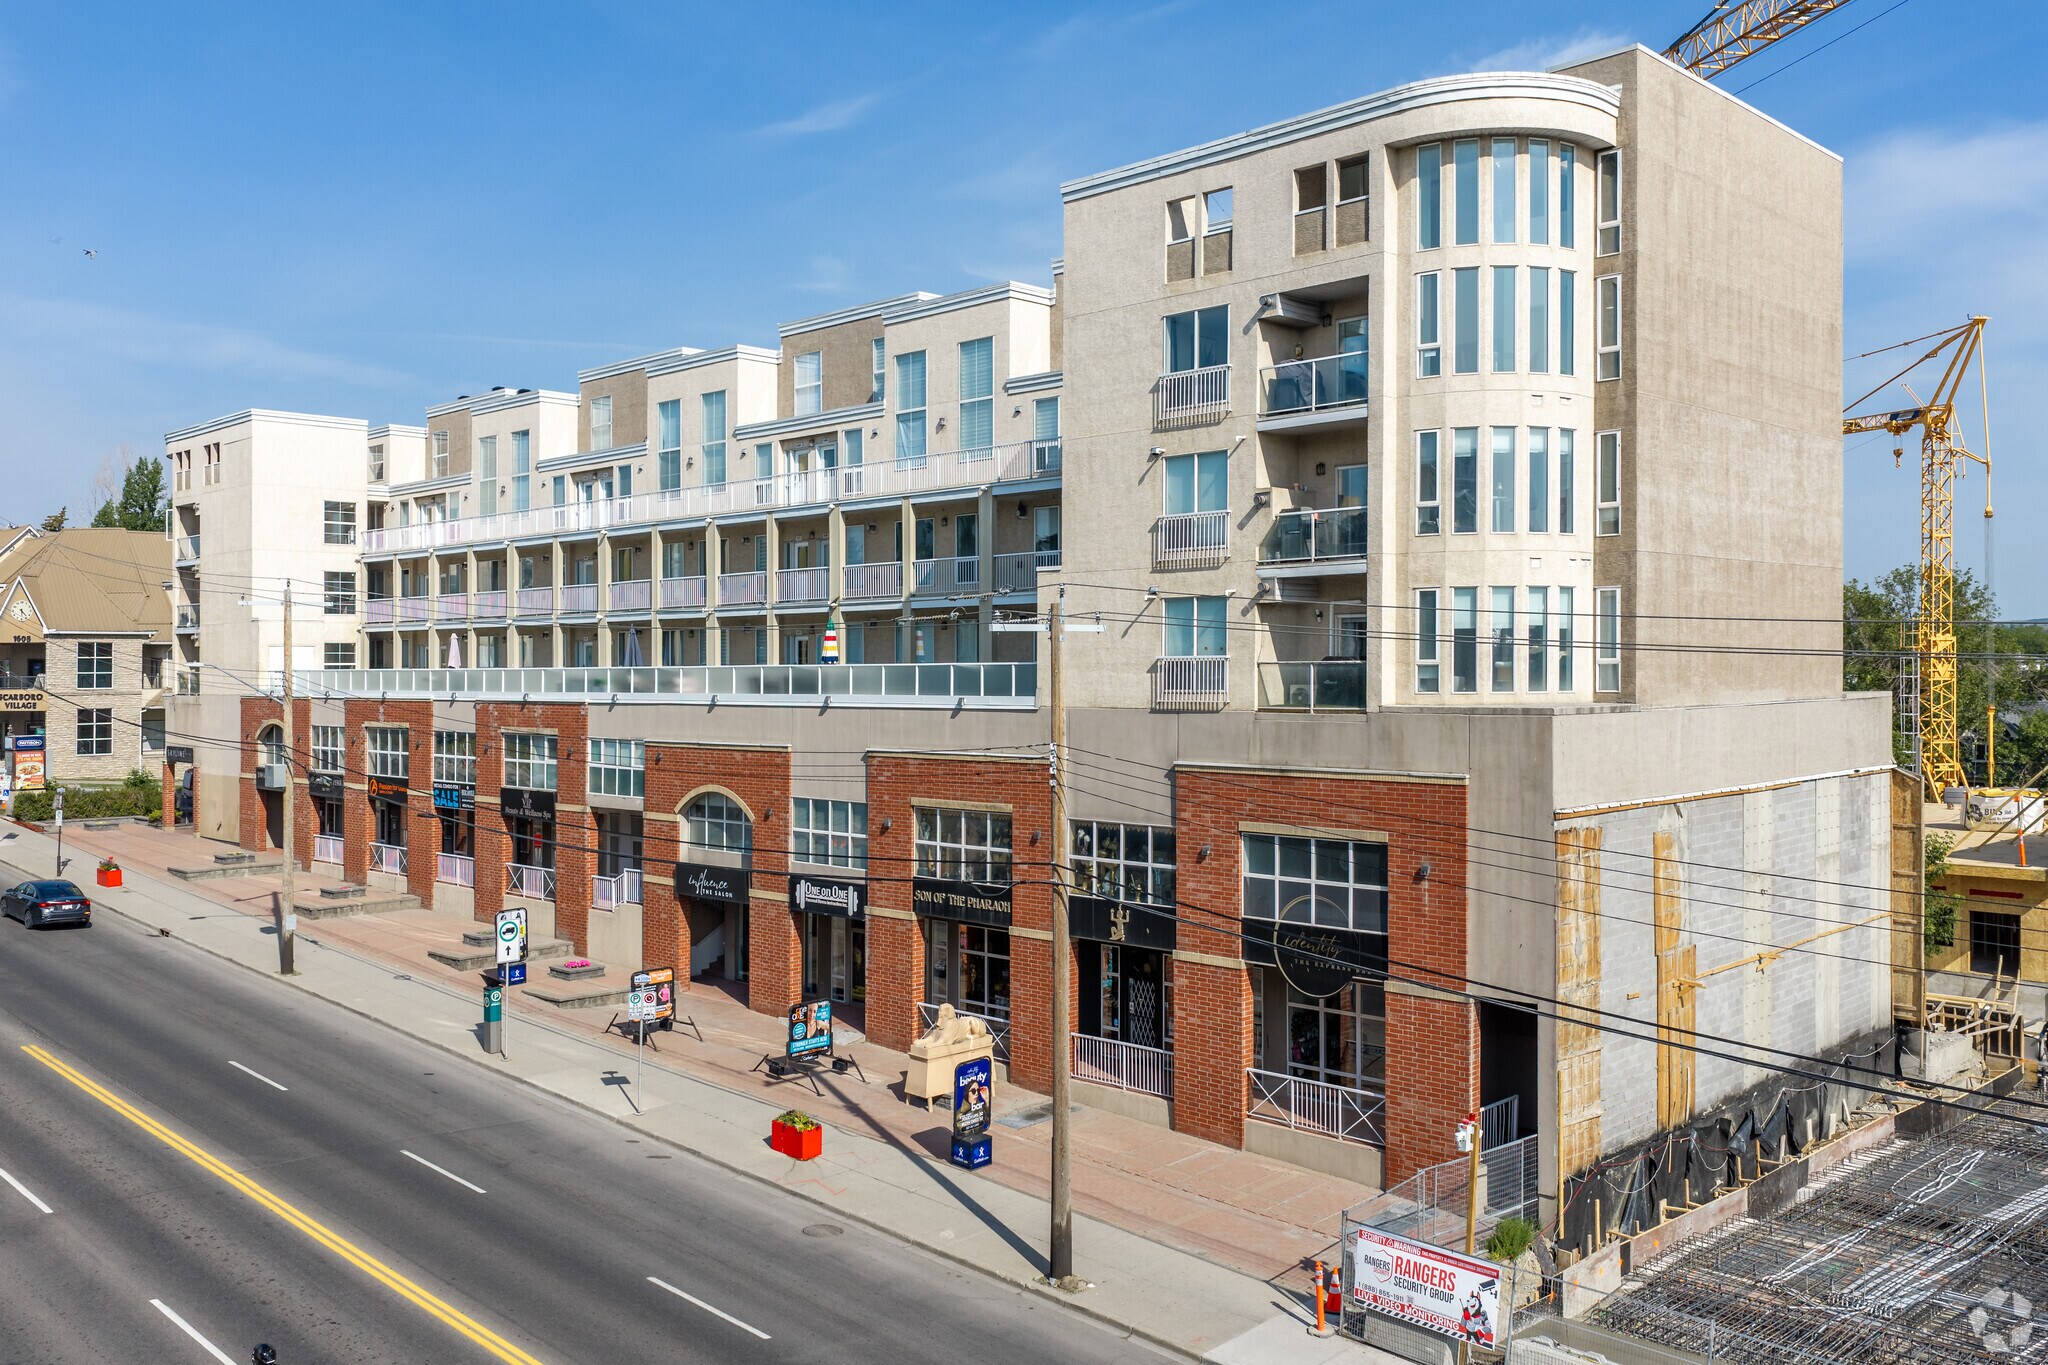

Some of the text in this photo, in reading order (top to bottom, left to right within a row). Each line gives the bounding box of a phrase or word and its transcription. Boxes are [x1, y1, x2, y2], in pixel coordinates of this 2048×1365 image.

[434, 790, 459, 808] SALE
[688, 869, 728, 894] influence
[914, 890, 1011, 912] SON OF THE PHARAOH
[1285, 932, 1342, 959] identity
[1315, 962, 1351, 972] EXPRESS
[960, 1072, 987, 1086] beauty
[972, 1102, 984, 1111] bar
[1362, 1231, 1386, 1246] SECURITY
[1394, 1240, 1421, 1256] WARNING
[1364, 1255, 1390, 1271] RANGERS
[1395, 1256, 1456, 1292] RANGERS
[1362, 1282, 1378, 1294] (888)
[1379, 1289, 1404, 1302] 855-1911
[1394, 1276, 1454, 1304] SECURITY GROUP
[1358, 1289, 1374, 1301] LIVE
[1377, 1295, 1401, 1311] VIDEO
[1404, 1303, 1460, 1330] MONITORING
